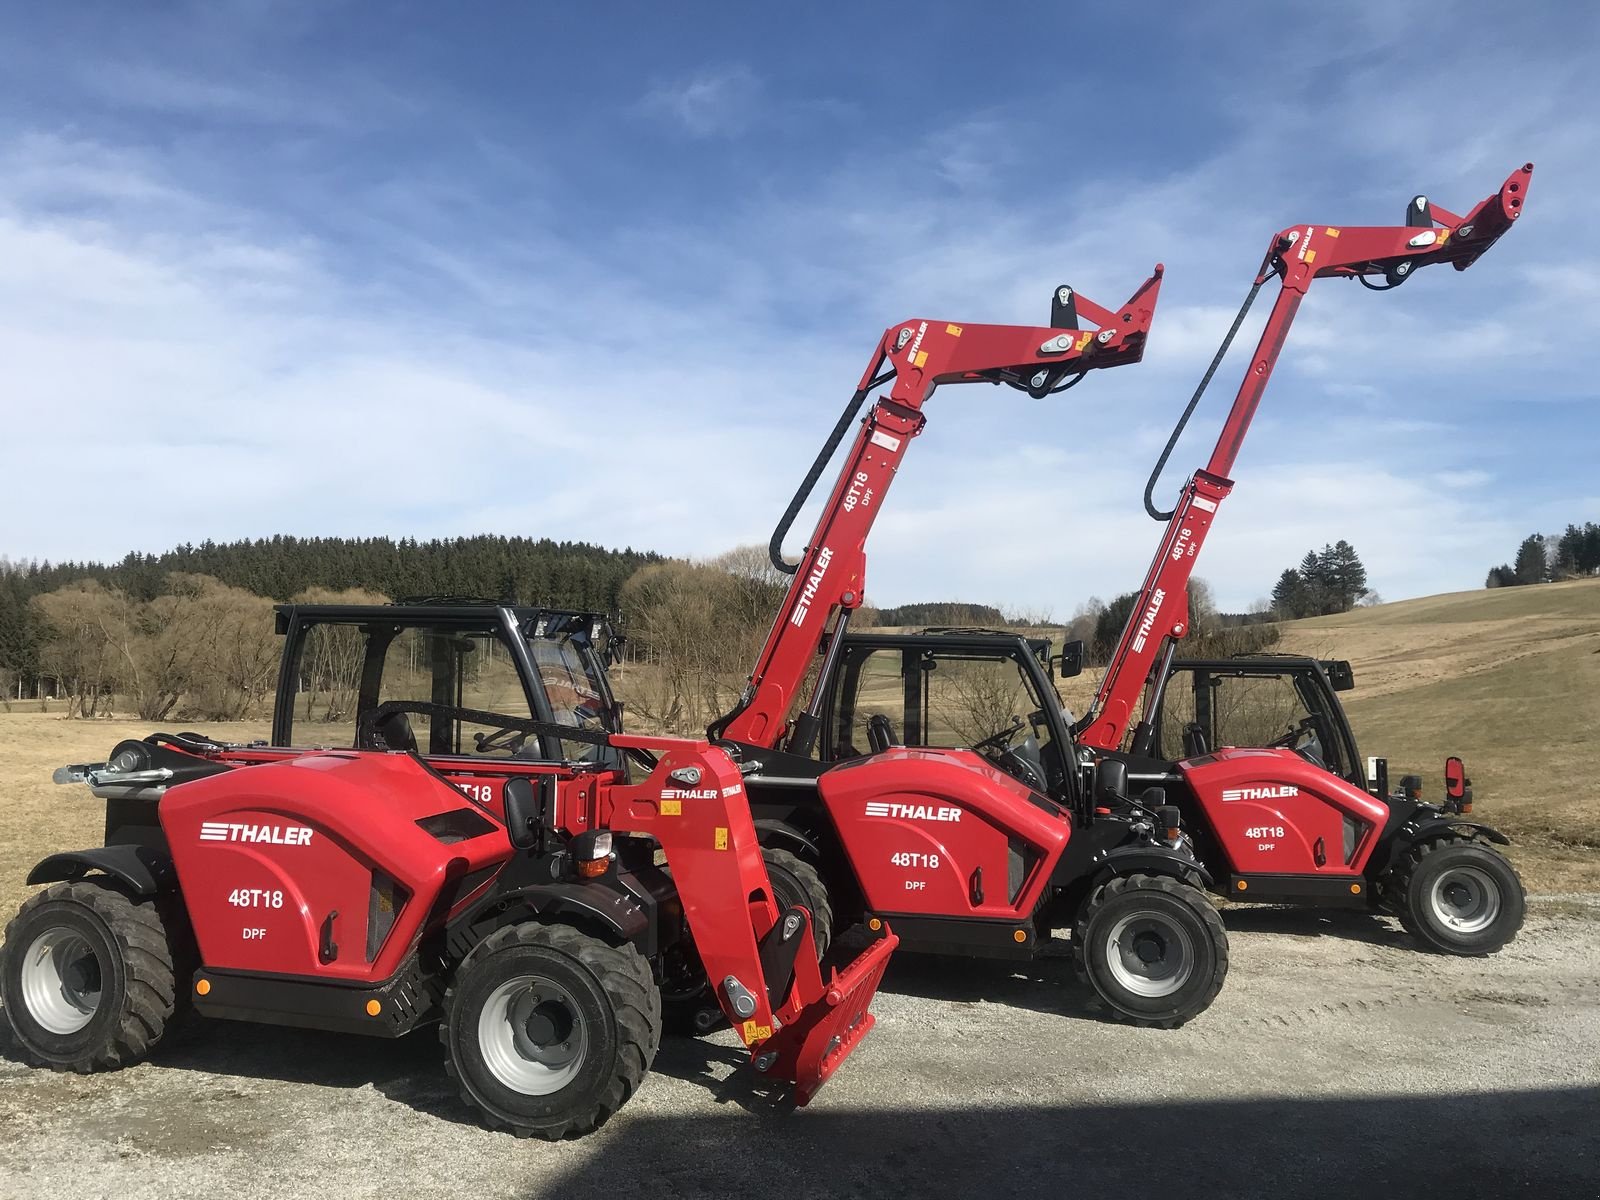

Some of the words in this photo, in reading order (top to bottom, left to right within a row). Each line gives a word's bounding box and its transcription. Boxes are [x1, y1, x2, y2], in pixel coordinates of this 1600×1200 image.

[909, 321, 929, 353] THALER
[843, 472, 868, 512] 48T18
[861, 488, 873, 506] DPF
[1172, 528, 1192, 561] 48T18
[1187, 541, 1197, 556] DPF
[803, 547, 834, 608] THALER
[1140, 589, 1166, 642] THALER
[454, 783, 492, 802] T18
[675, 790, 717, 799] THALER
[1240, 785, 1299, 800] THALER
[888, 803, 962, 822] THALER
[229, 823, 313, 846] THALER
[1245, 826, 1285, 839] 48T18
[1258, 843, 1276, 851] DPF
[890, 851, 940, 869] 48T18
[905, 880, 926, 891] DPF
[228, 888, 283, 909] 48T18
[242, 927, 267, 940] DPF
